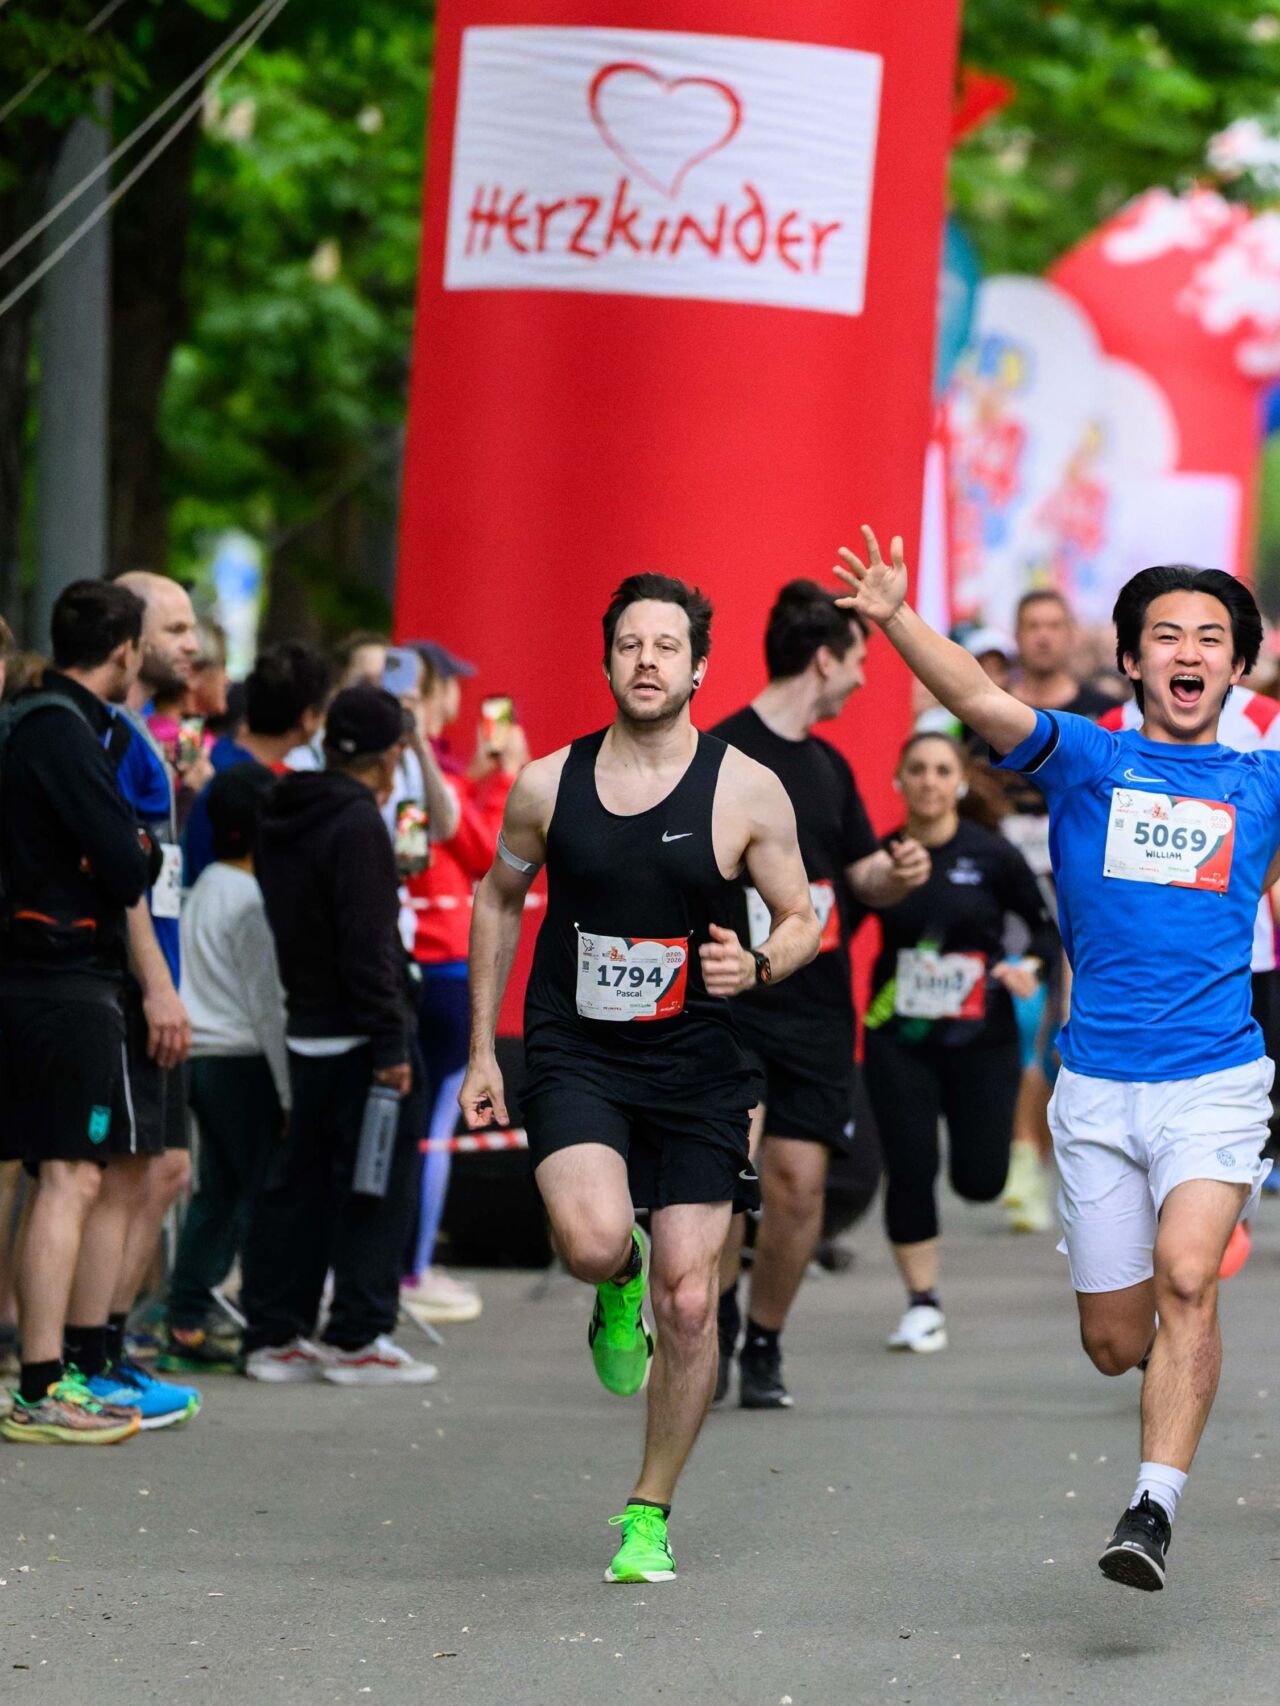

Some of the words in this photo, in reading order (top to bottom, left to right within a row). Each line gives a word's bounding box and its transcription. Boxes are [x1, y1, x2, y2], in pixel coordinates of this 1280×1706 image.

[1134, 821, 1207, 852] 5069
[1145, 849, 1182, 861] WILLIAM
[597, 964, 663, 988] 1794
[616, 989, 642, 998] Pascal
